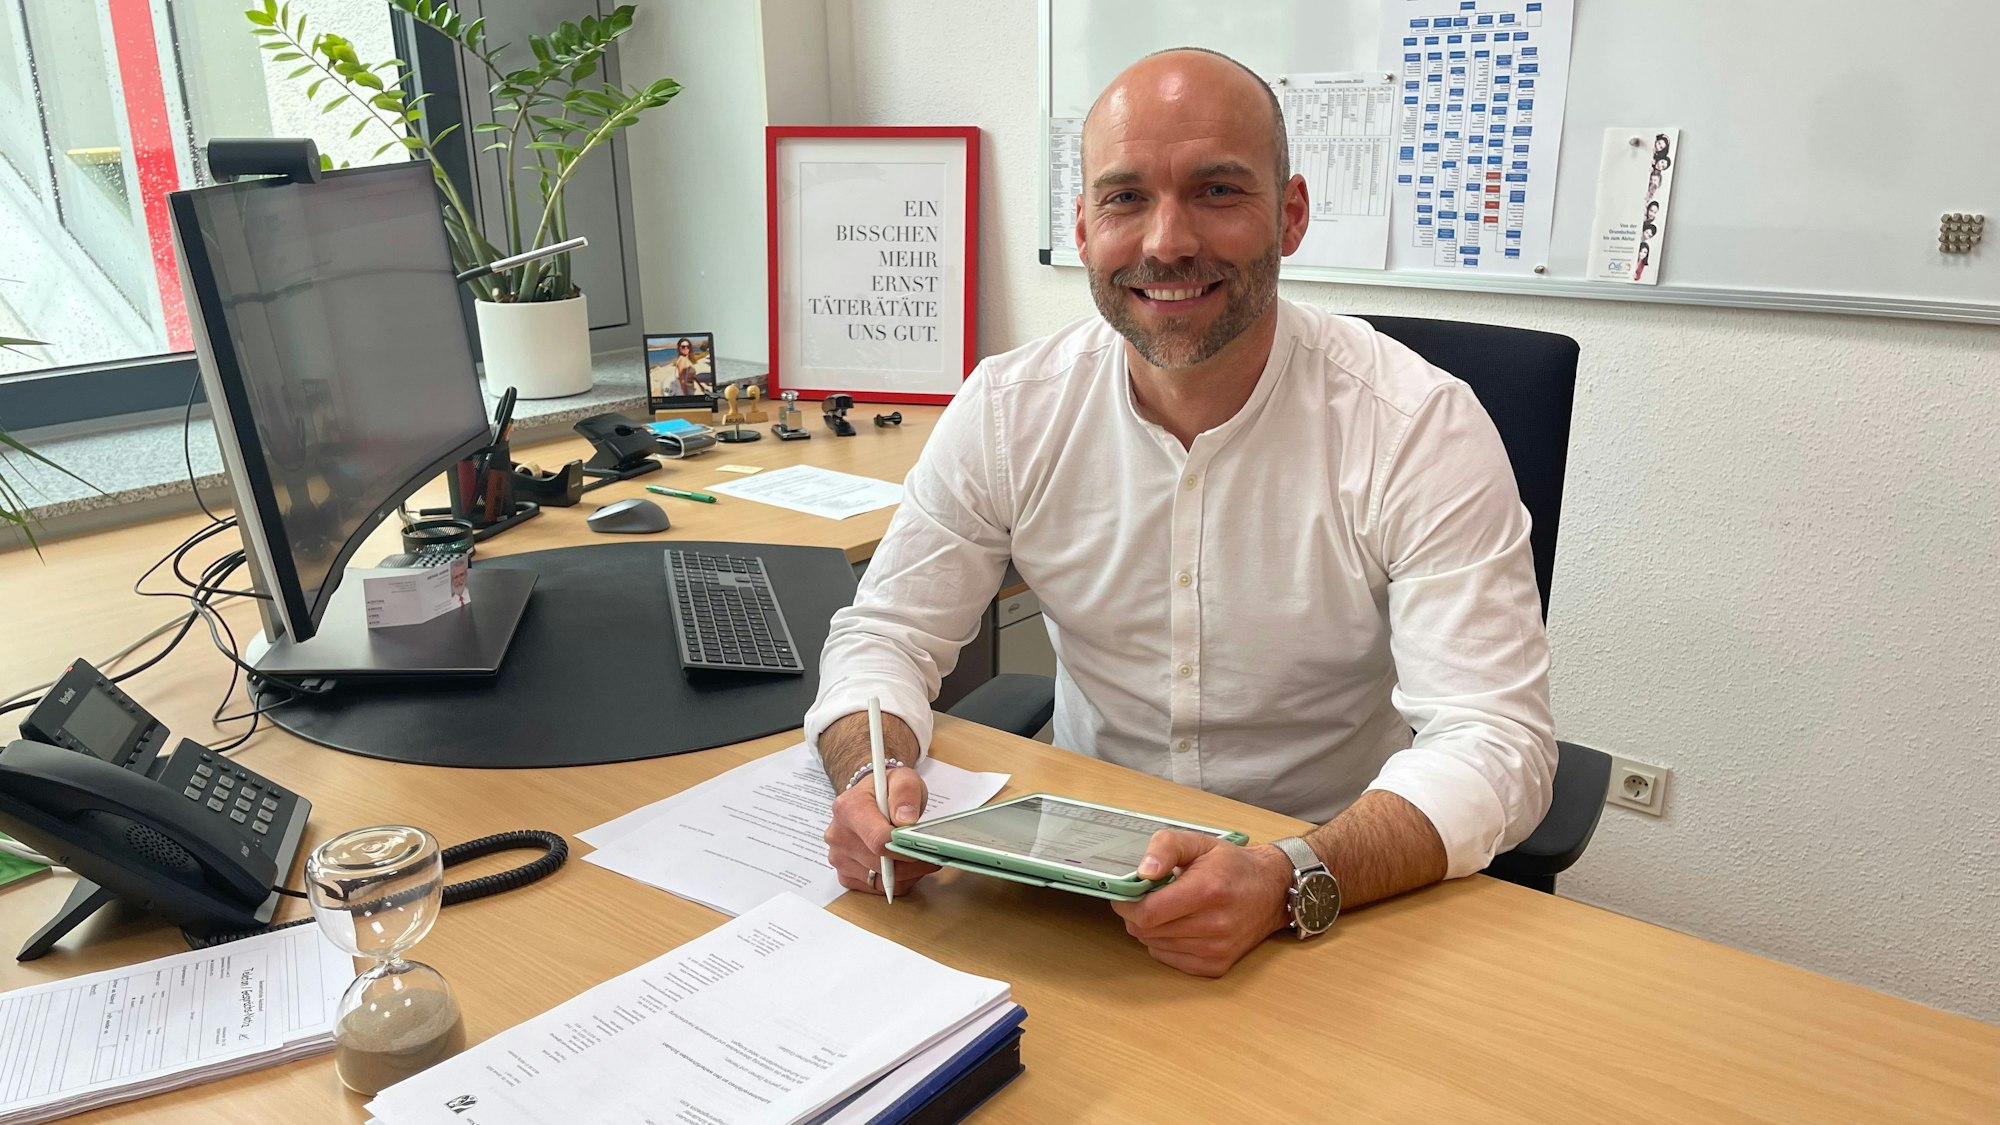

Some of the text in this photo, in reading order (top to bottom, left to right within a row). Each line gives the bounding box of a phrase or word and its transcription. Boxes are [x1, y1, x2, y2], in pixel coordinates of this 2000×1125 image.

[904, 200, 939, 217] EIN
[836, 225, 939, 243] BISSCHEN
[878, 250, 938, 268] MEHR
[872, 275, 938, 293] ERNST
[808, 295, 938, 318] TÄTERÄTÄTE
[847, 323, 938, 343] UNS GUT.
